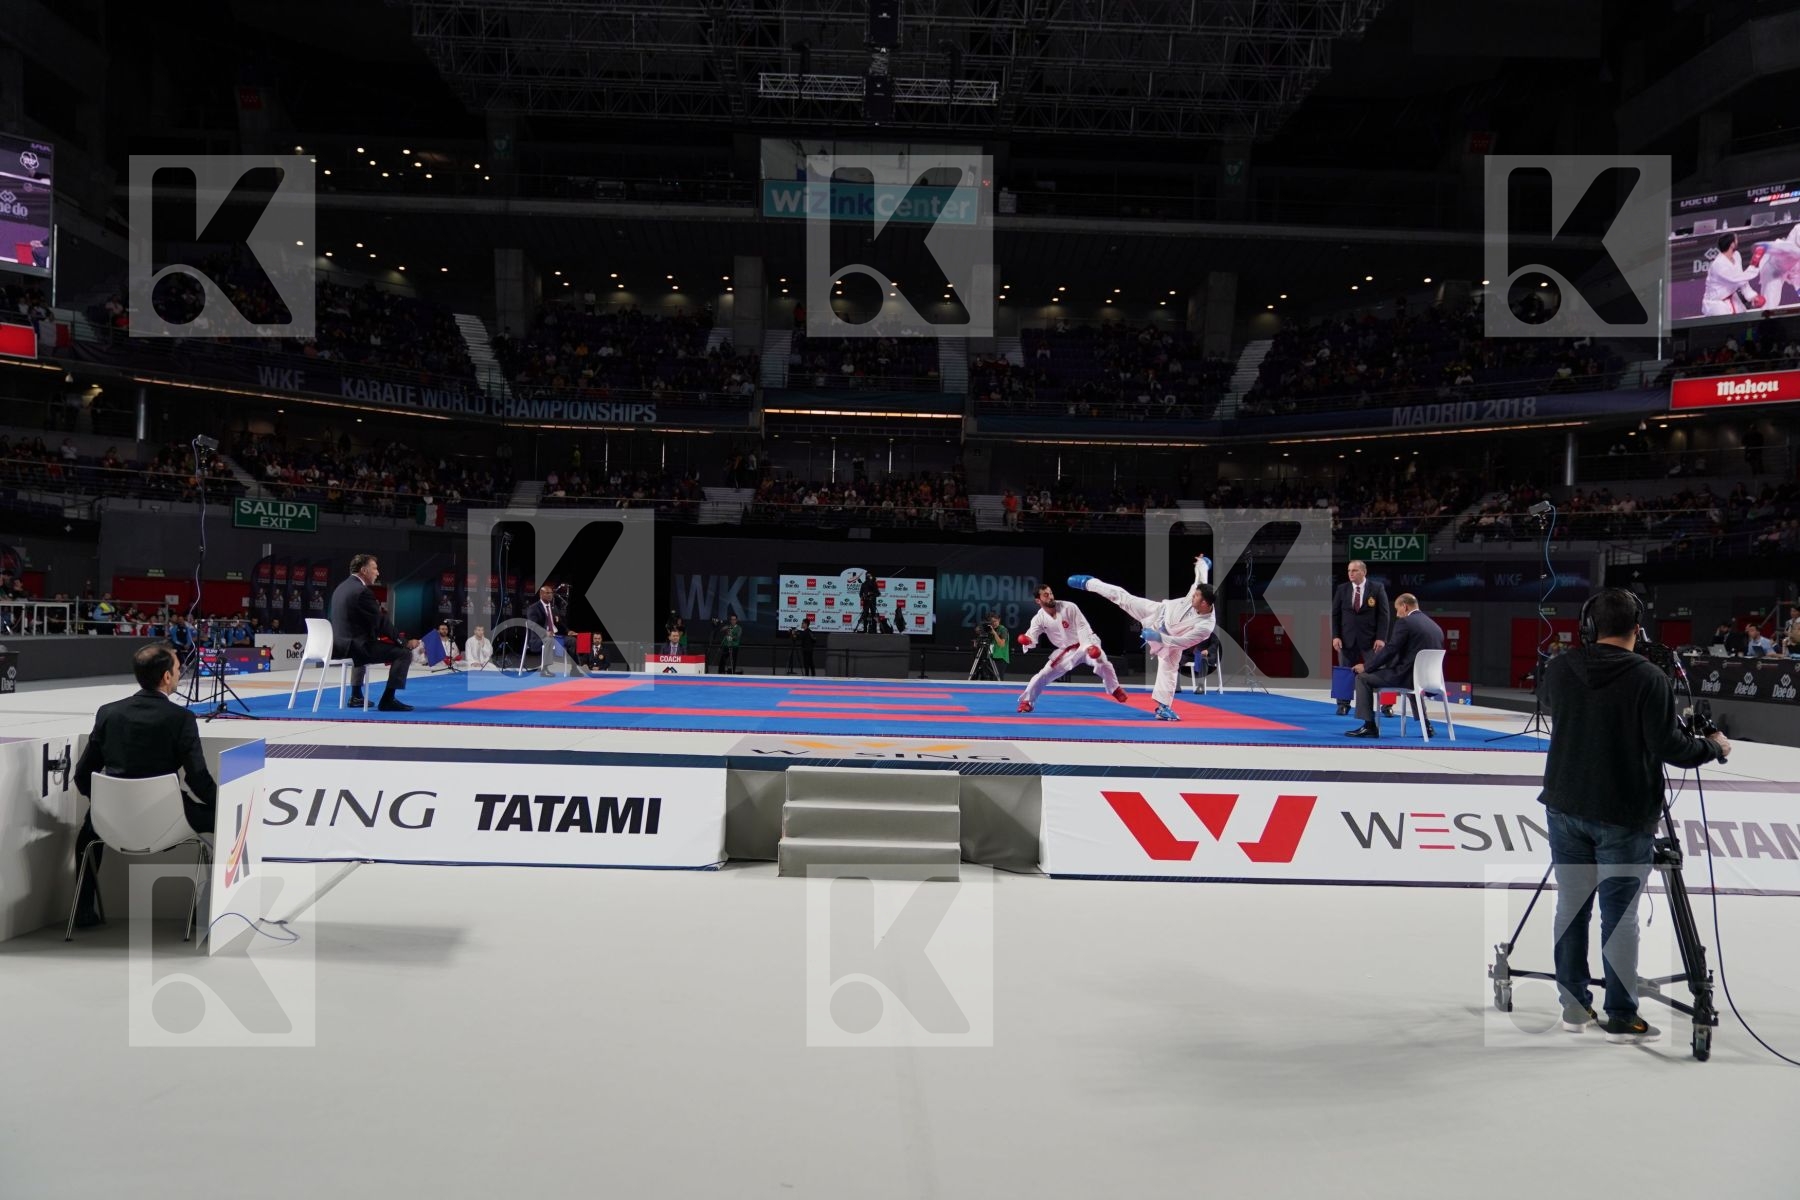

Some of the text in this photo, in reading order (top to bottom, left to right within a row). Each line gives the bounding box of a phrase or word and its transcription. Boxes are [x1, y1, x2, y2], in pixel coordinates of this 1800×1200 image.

[257, 365, 306, 391] WKF
[1716, 379, 1779, 396] Mahou
[340, 376, 657, 423] KARATE WORLD CHAMPIONSHIPS
[1392, 396, 1536, 427] MADRID 2018
[240, 500, 312, 519] SALIDA
[260, 516, 292, 529] EXIT
[1353, 536, 1420, 550] SALIDA
[1371, 550, 1401, 560] EXIT
[941, 573, 1040, 601] MADRID
[1494, 573, 1523, 586] WKF
[674, 574, 773, 622] WKF
[660, 655, 681, 663] COACH
[474, 794, 662, 834] TATAMI
[1340, 810, 1550, 852] WESIN
